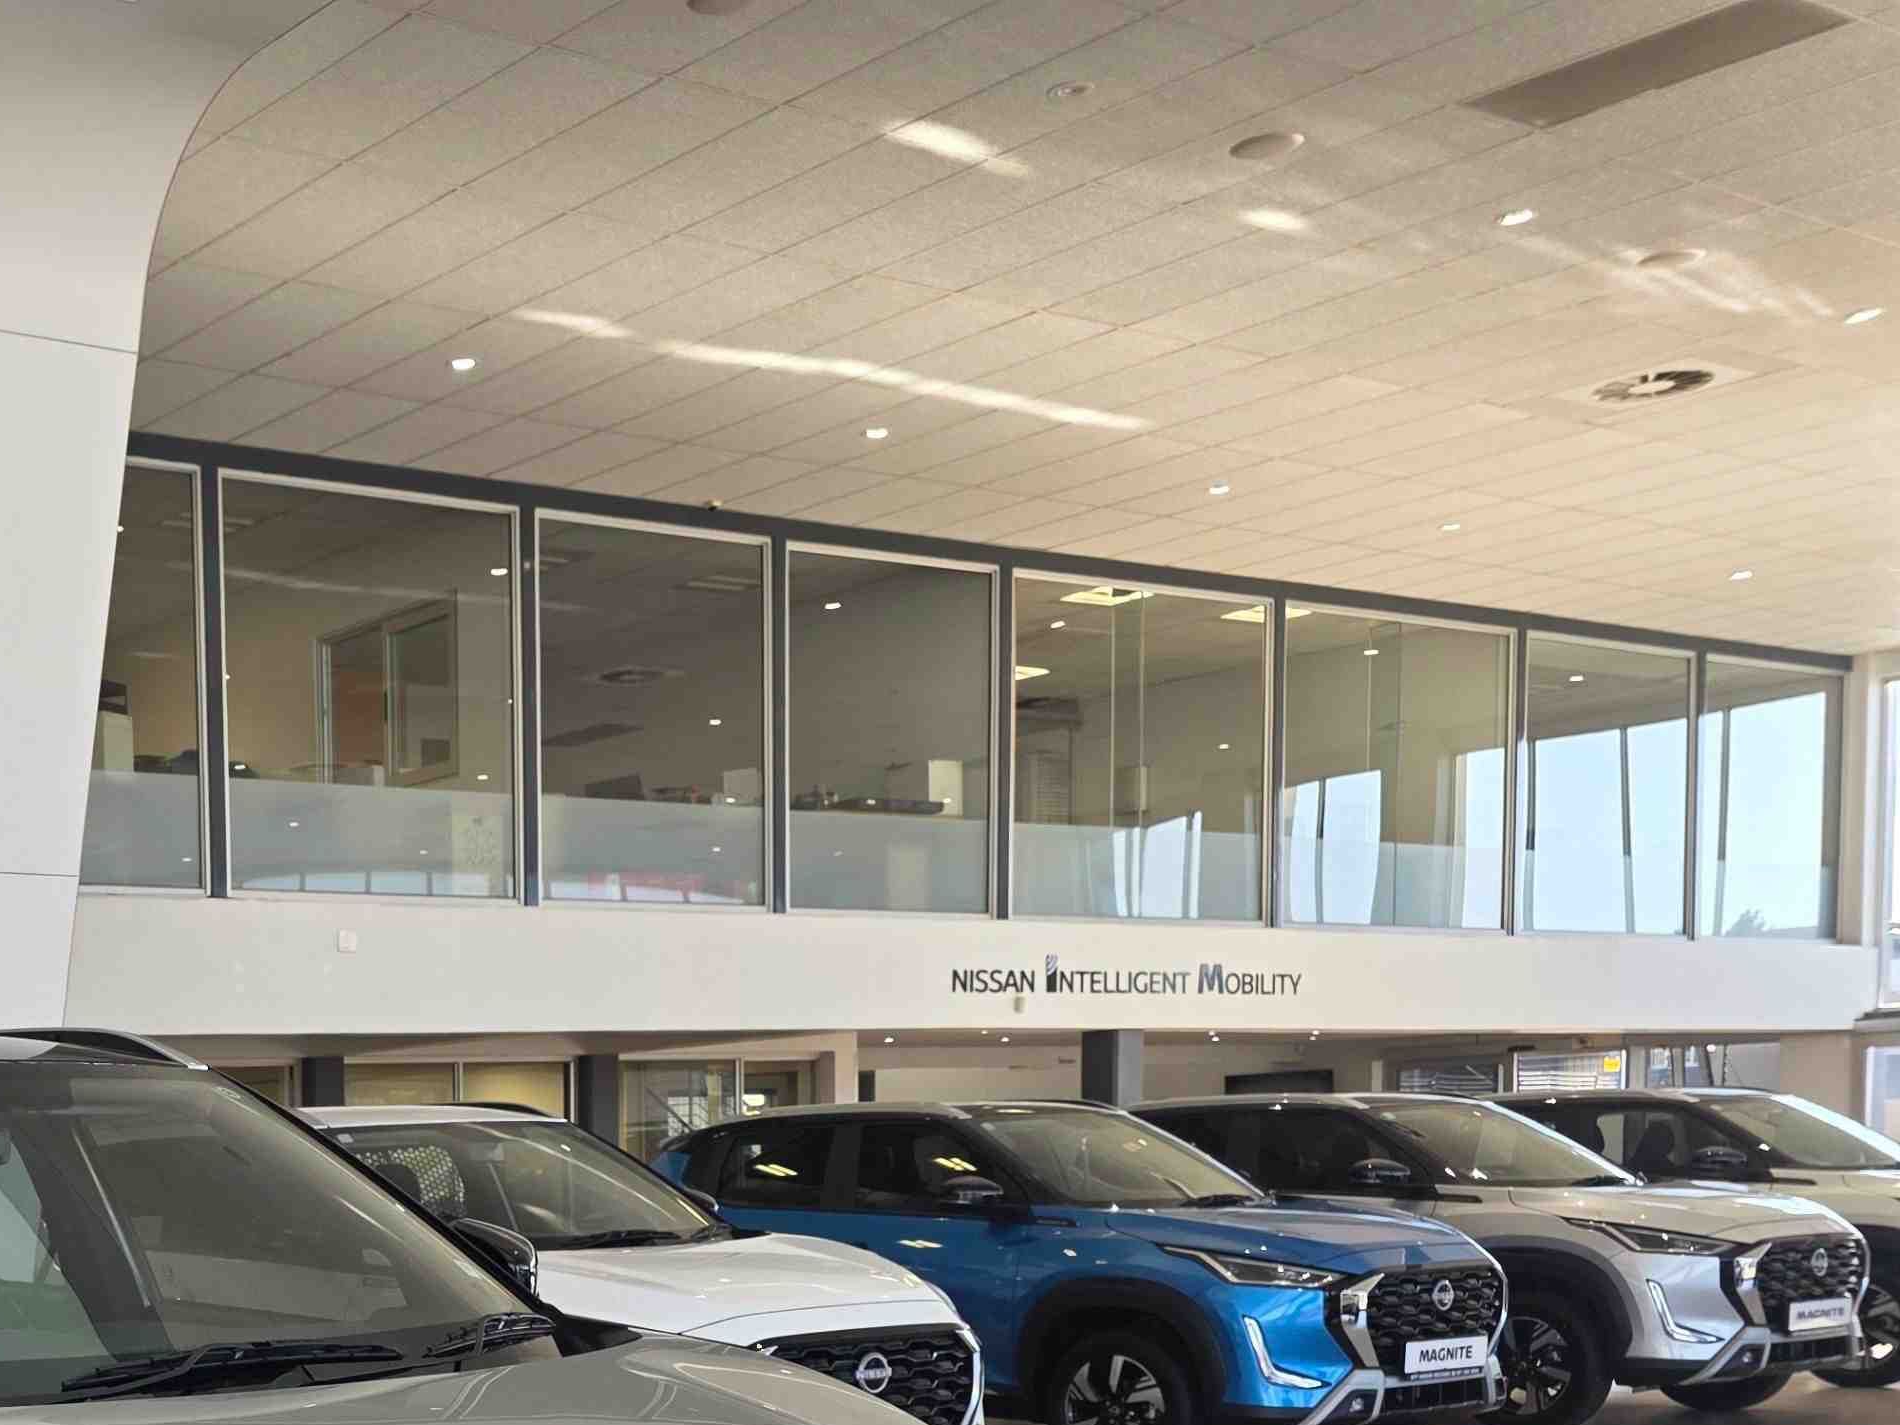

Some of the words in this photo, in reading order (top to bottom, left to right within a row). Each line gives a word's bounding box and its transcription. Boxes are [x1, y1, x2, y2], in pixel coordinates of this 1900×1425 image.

[951, 969, 1035, 993] NISSAN
[1045, 954, 1191, 994] INTELLIGENT
[1197, 963, 1302, 995] MOBILITY
[1419, 1345, 1472, 1362] MAGNITE
